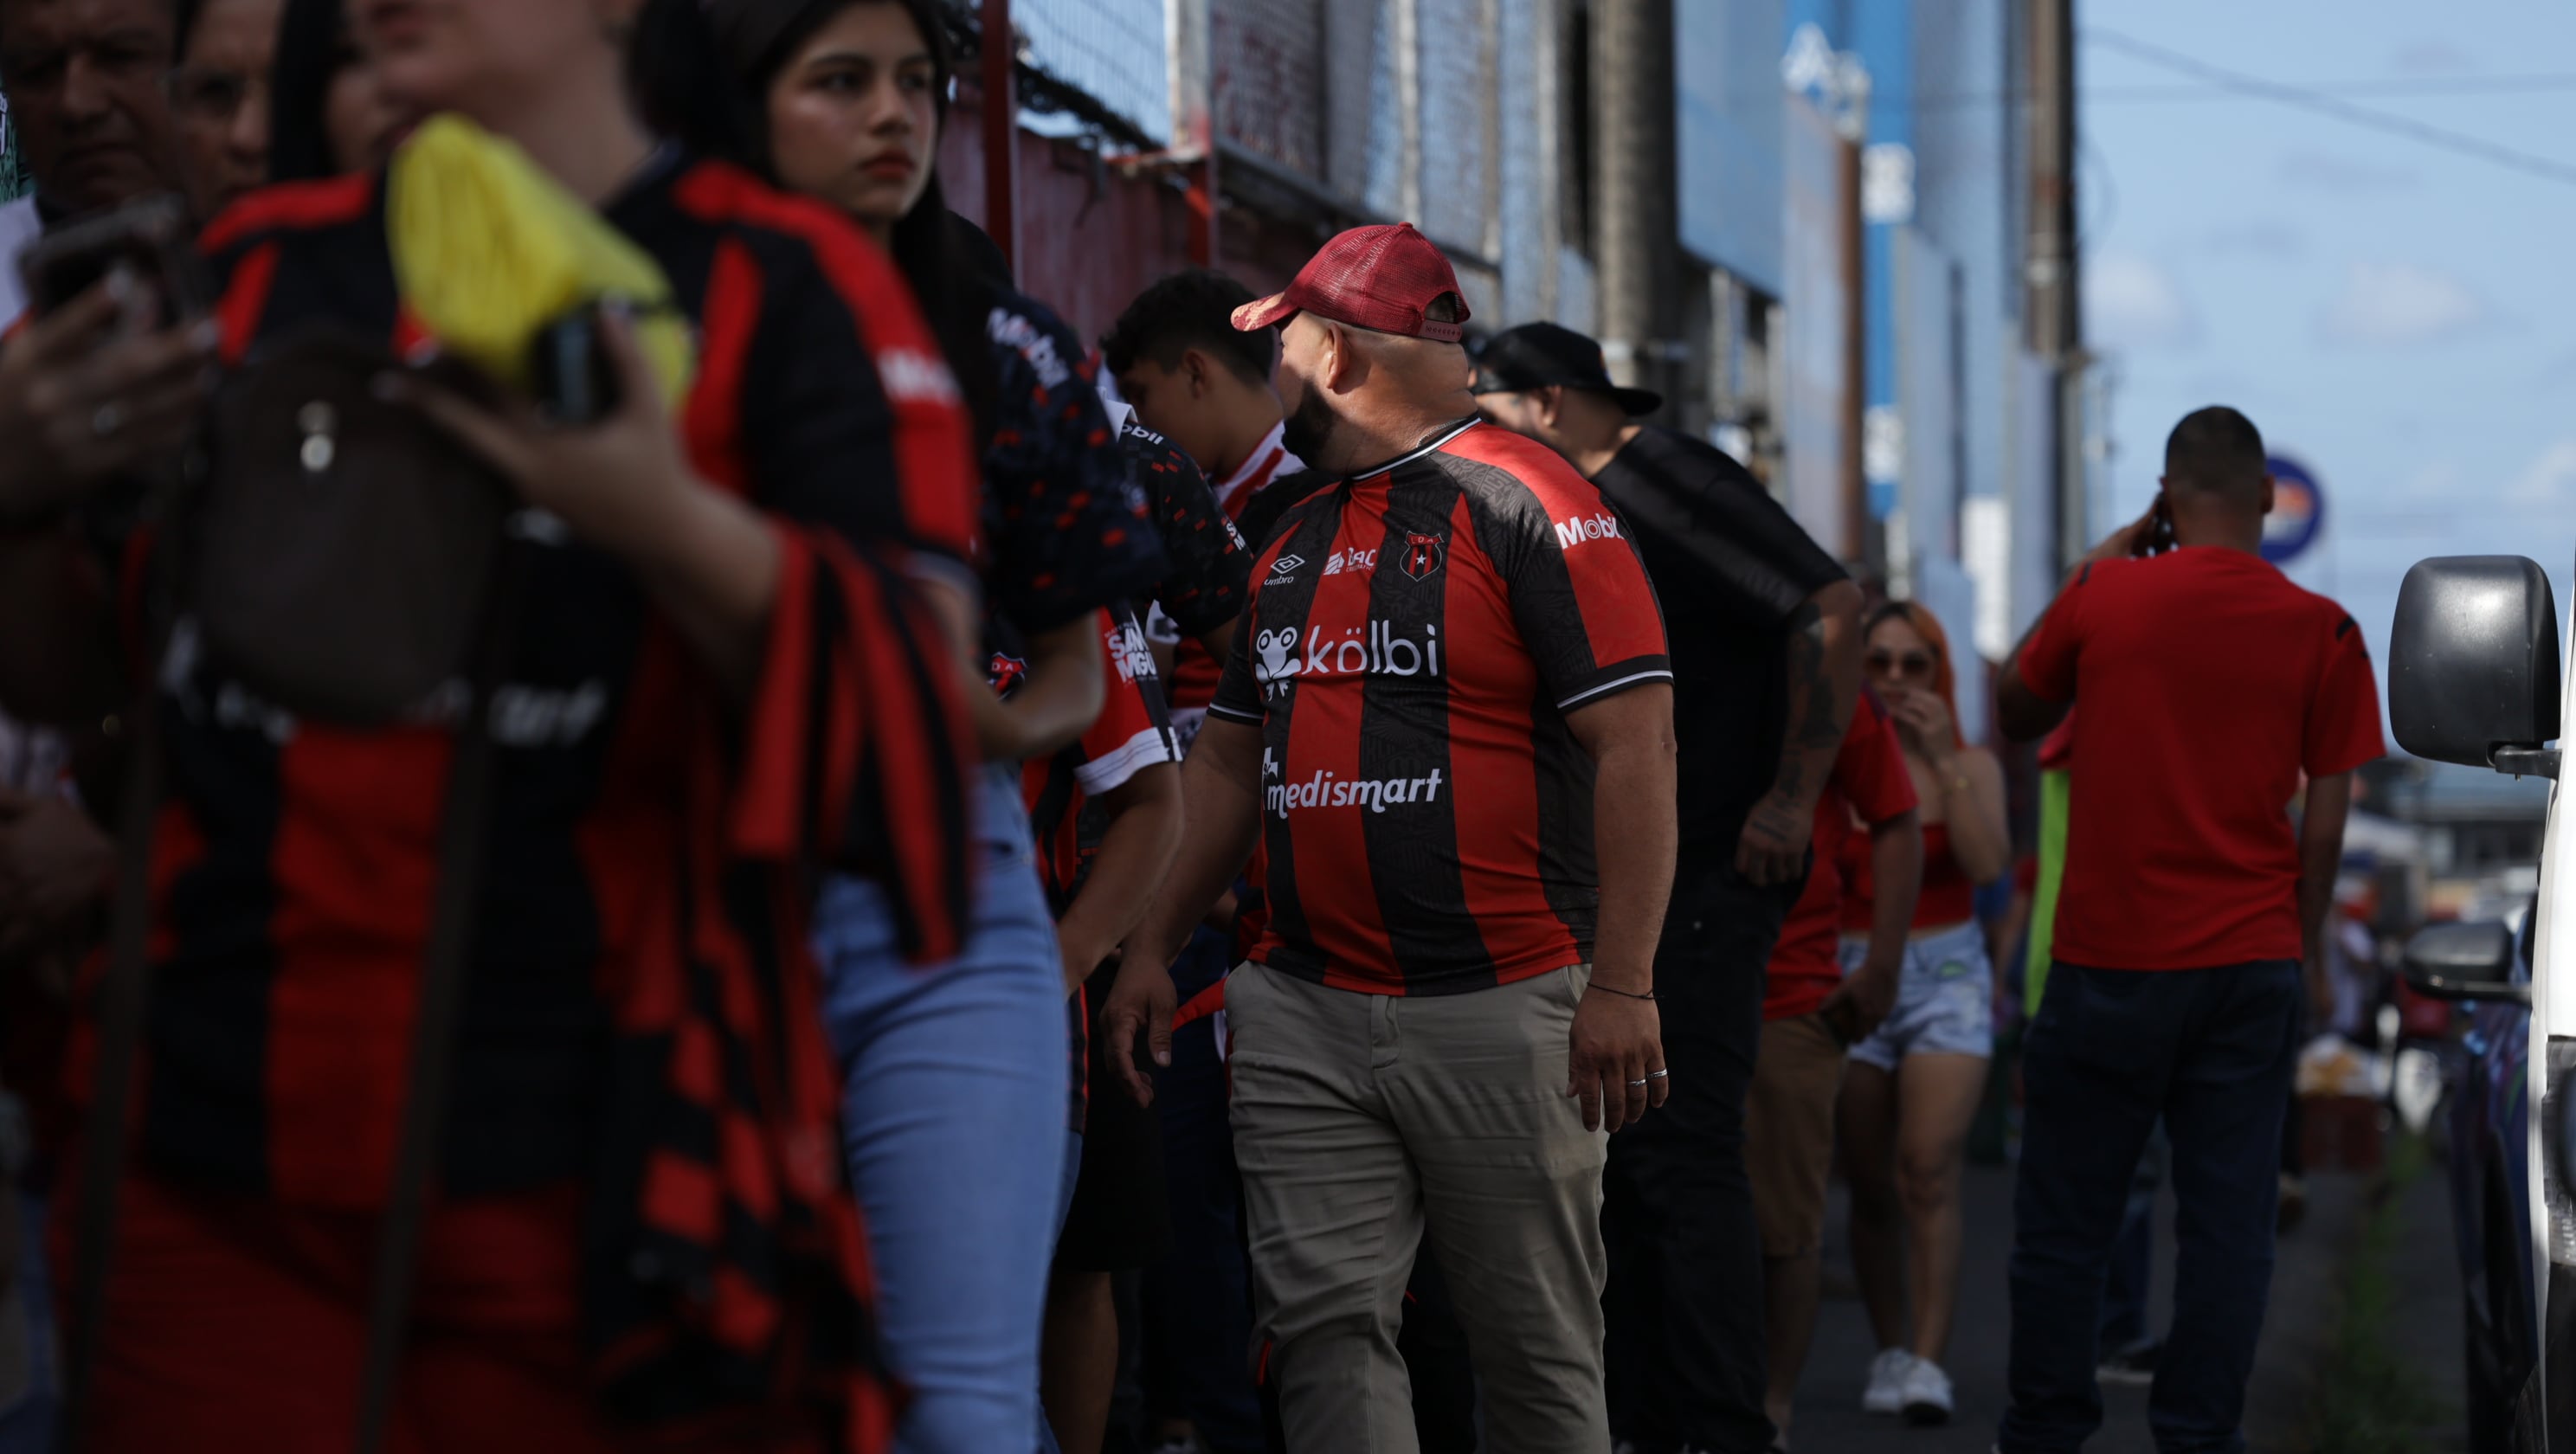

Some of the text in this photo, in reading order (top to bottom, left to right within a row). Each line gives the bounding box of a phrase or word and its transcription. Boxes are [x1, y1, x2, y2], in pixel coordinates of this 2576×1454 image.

[1122, 423, 1164, 445] obil
[1555, 512, 1625, 550] Mobil
[1348, 547, 1376, 567] BAC
[1264, 575, 1294, 586] umbro
[1301, 620, 1438, 676] kölbi
[991, 661, 1014, 672] DA
[1267, 768, 1442, 820] medismart
